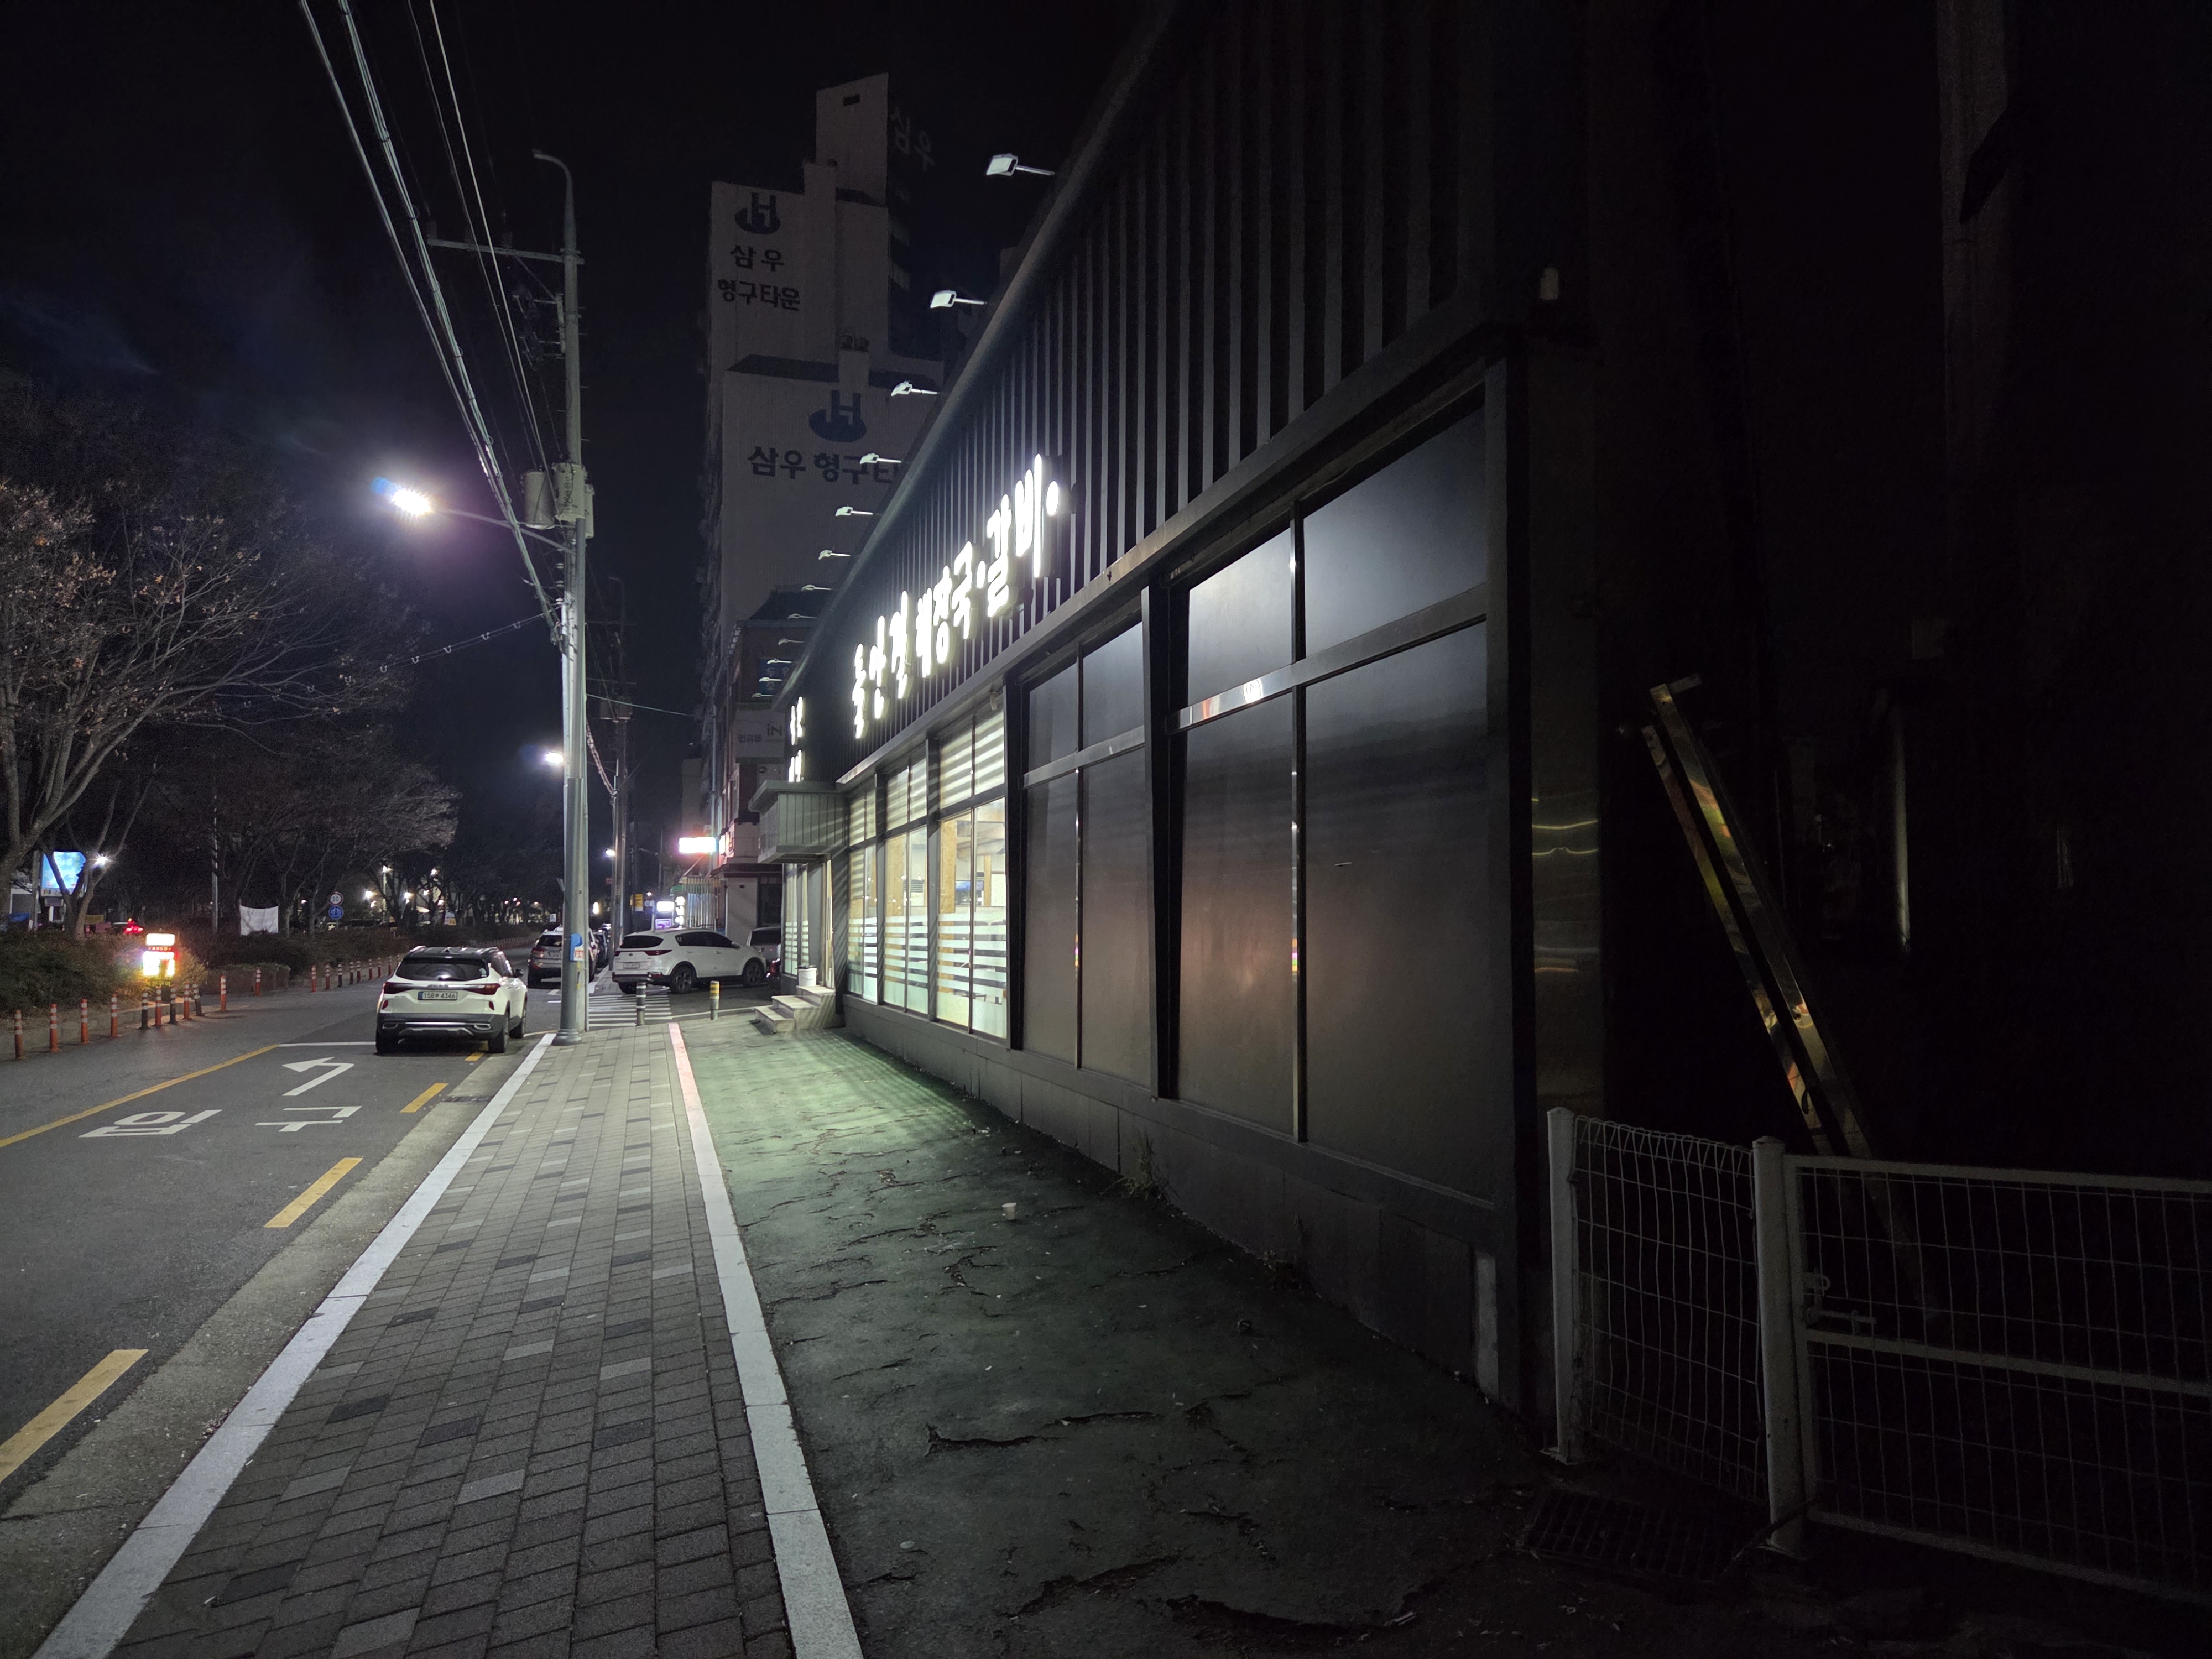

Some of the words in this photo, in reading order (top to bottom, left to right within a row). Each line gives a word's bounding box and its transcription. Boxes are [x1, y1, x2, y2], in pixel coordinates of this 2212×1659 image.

[731, 245, 785, 272] 삼우
[718, 279, 800, 311] 형구타운
[748, 446, 806, 479] 삼우
